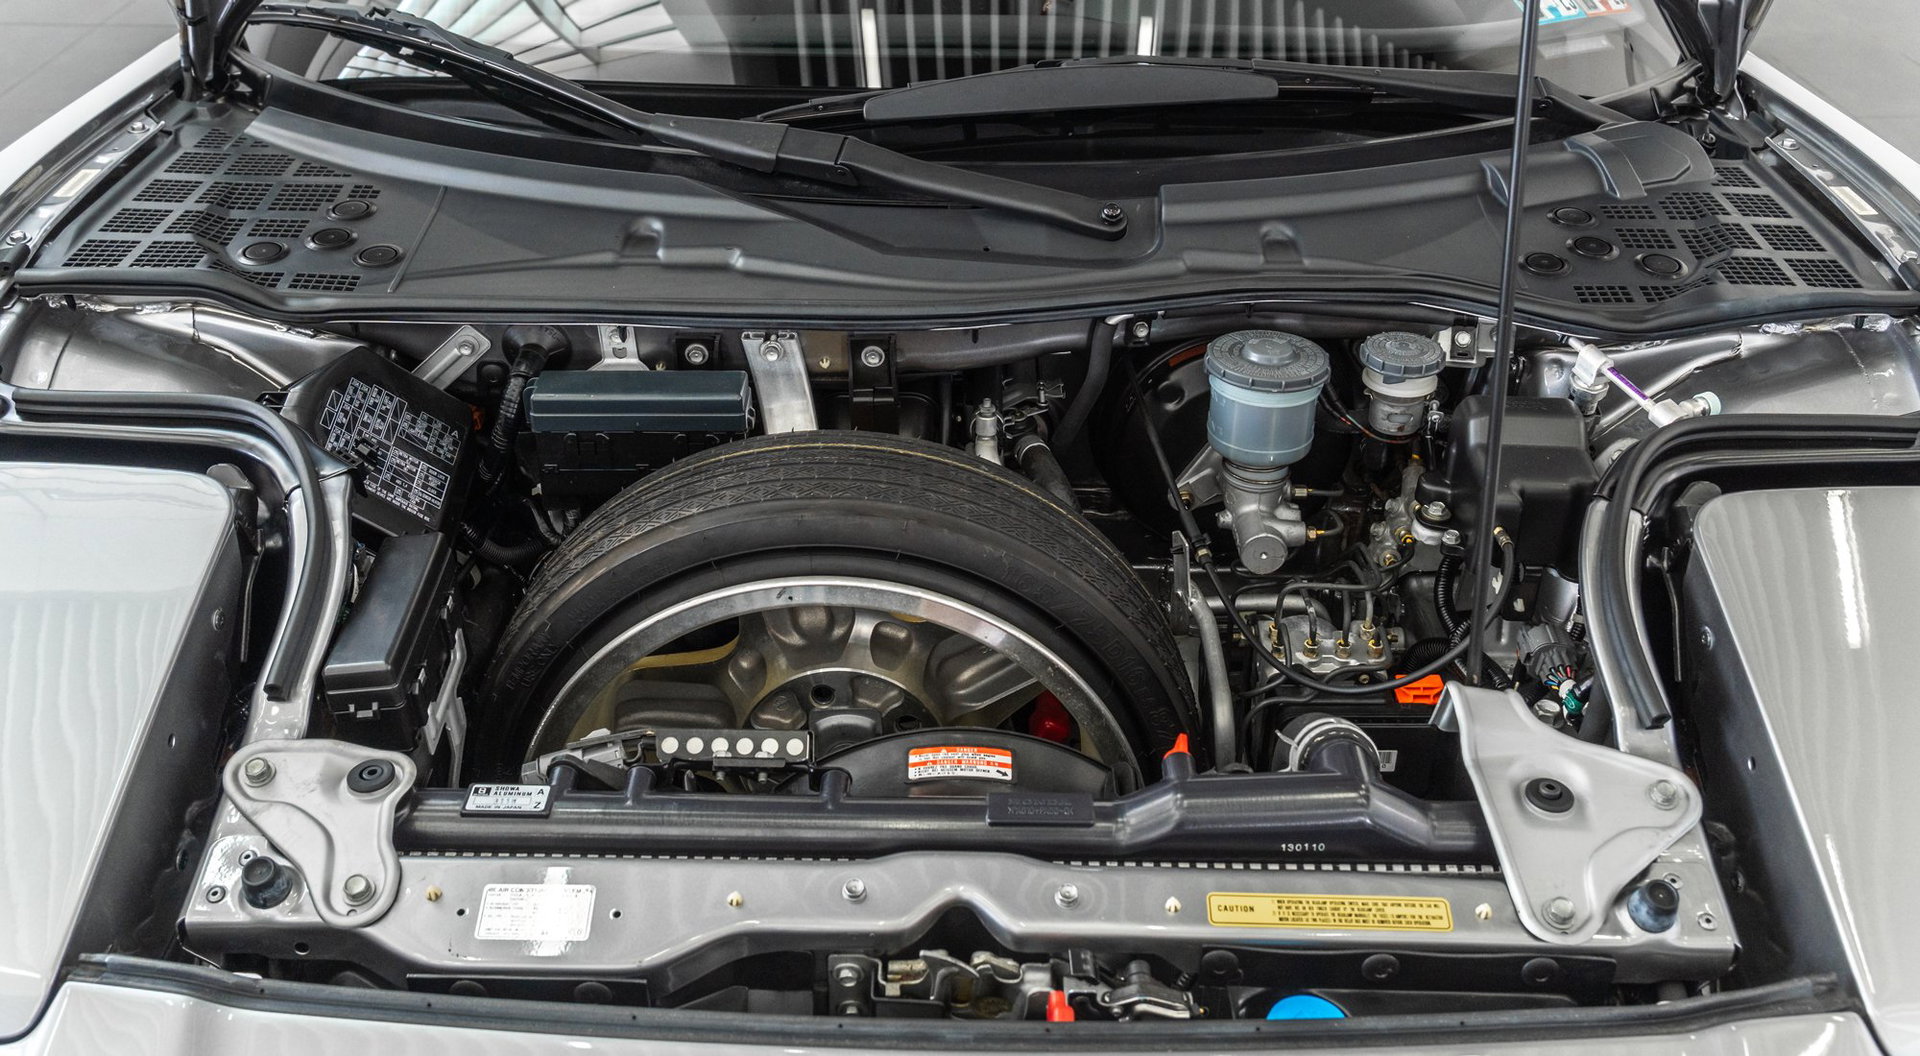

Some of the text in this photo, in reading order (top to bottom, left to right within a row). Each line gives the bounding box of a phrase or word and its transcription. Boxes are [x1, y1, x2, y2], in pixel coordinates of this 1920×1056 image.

[450, 430, 459, 439] A
[533, 801, 541, 809] Z
[1280, 842, 1326, 852] 130110
[1217, 904, 1255, 913] CAUTION
